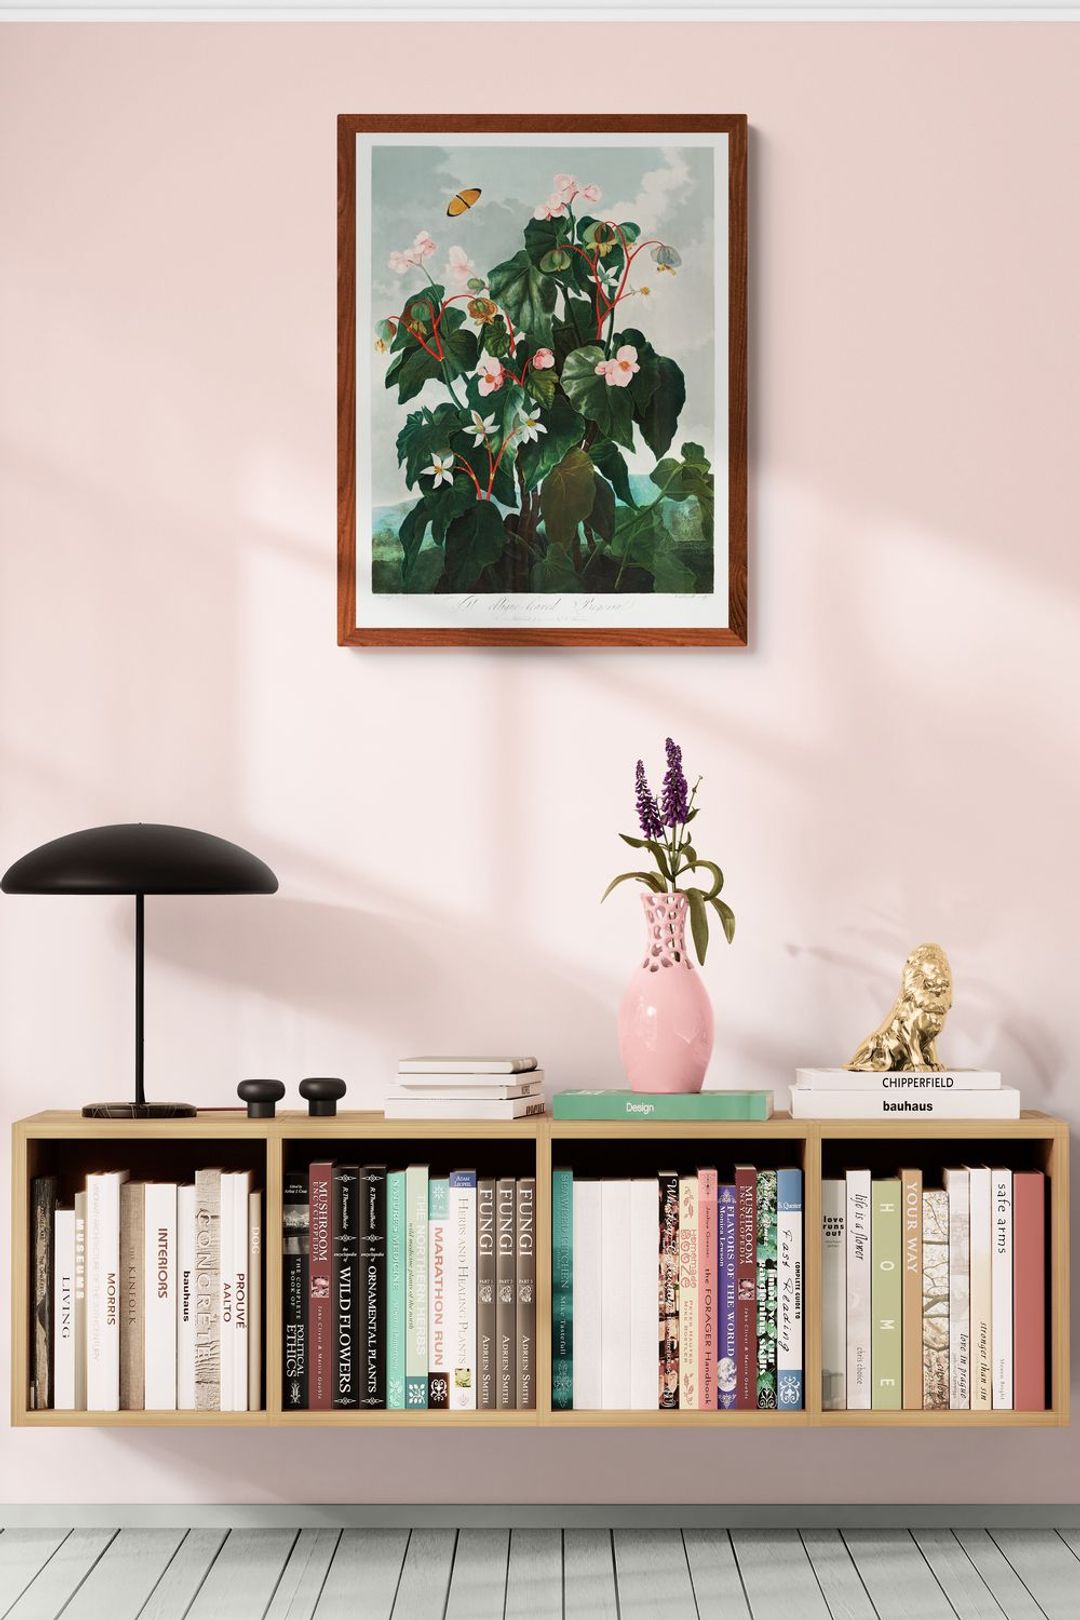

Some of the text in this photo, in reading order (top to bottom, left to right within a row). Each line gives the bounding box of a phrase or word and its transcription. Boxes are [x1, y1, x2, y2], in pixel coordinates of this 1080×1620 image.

[626, 1102, 655, 1114] Design
[882, 1077, 954, 1088] CHIPPERFIELD
[883, 1101, 933, 1112] bauhaus
[319, 1181, 327, 1261] MUSHROOM
[479, 1189, 492, 1256] FUNGI
[499, 1189, 512, 1256] FUNGI
[519, 1189, 532, 1256] FUNGI
[745, 1185, 753, 1263] MUSHROOM
[850, 1194, 868, 1209] life
[855, 1211, 866, 1220] is
[907, 1182, 918, 1273] YOUR WAY
[996, 1183, 1010, 1254] safe arms
[75, 1219, 84, 1299] MUSEUMS
[158, 1228, 168, 1298] INTERIORS
[251, 1227, 260, 1254] DOG
[417, 1225, 426, 1302] NORTHERN
[850, 1230, 868, 1260] flower
[62, 1276, 70, 1339] LIVING
[107, 1273, 116, 1325] MORRIS
[128, 1266, 136, 1326] KINFOLK
[183, 1271, 191, 1322] bauhaus
[223, 1283, 231, 1322] AALTO
[236, 1273, 247, 1329] PROUVÉ
[434, 1227, 442, 1326] MARATHON
[727, 1206, 735, 1357] FLAVORS OF THE WORLD
[778, 1230, 793, 1352] Fast Reading
[880, 1203, 895, 1387] HOME
[286, 1324, 296, 1377] ETHICS
[339, 1267, 350, 1393] WILD FLOWERS
[368, 1266, 377, 1393] ORNAMENTAL PLANTS
[434, 1331, 442, 1365] RUN
[978, 1322, 989, 1401] stronger than sin
[857, 1347, 865, 1384] chris choice
[957, 1334, 968, 1399] love in prague
